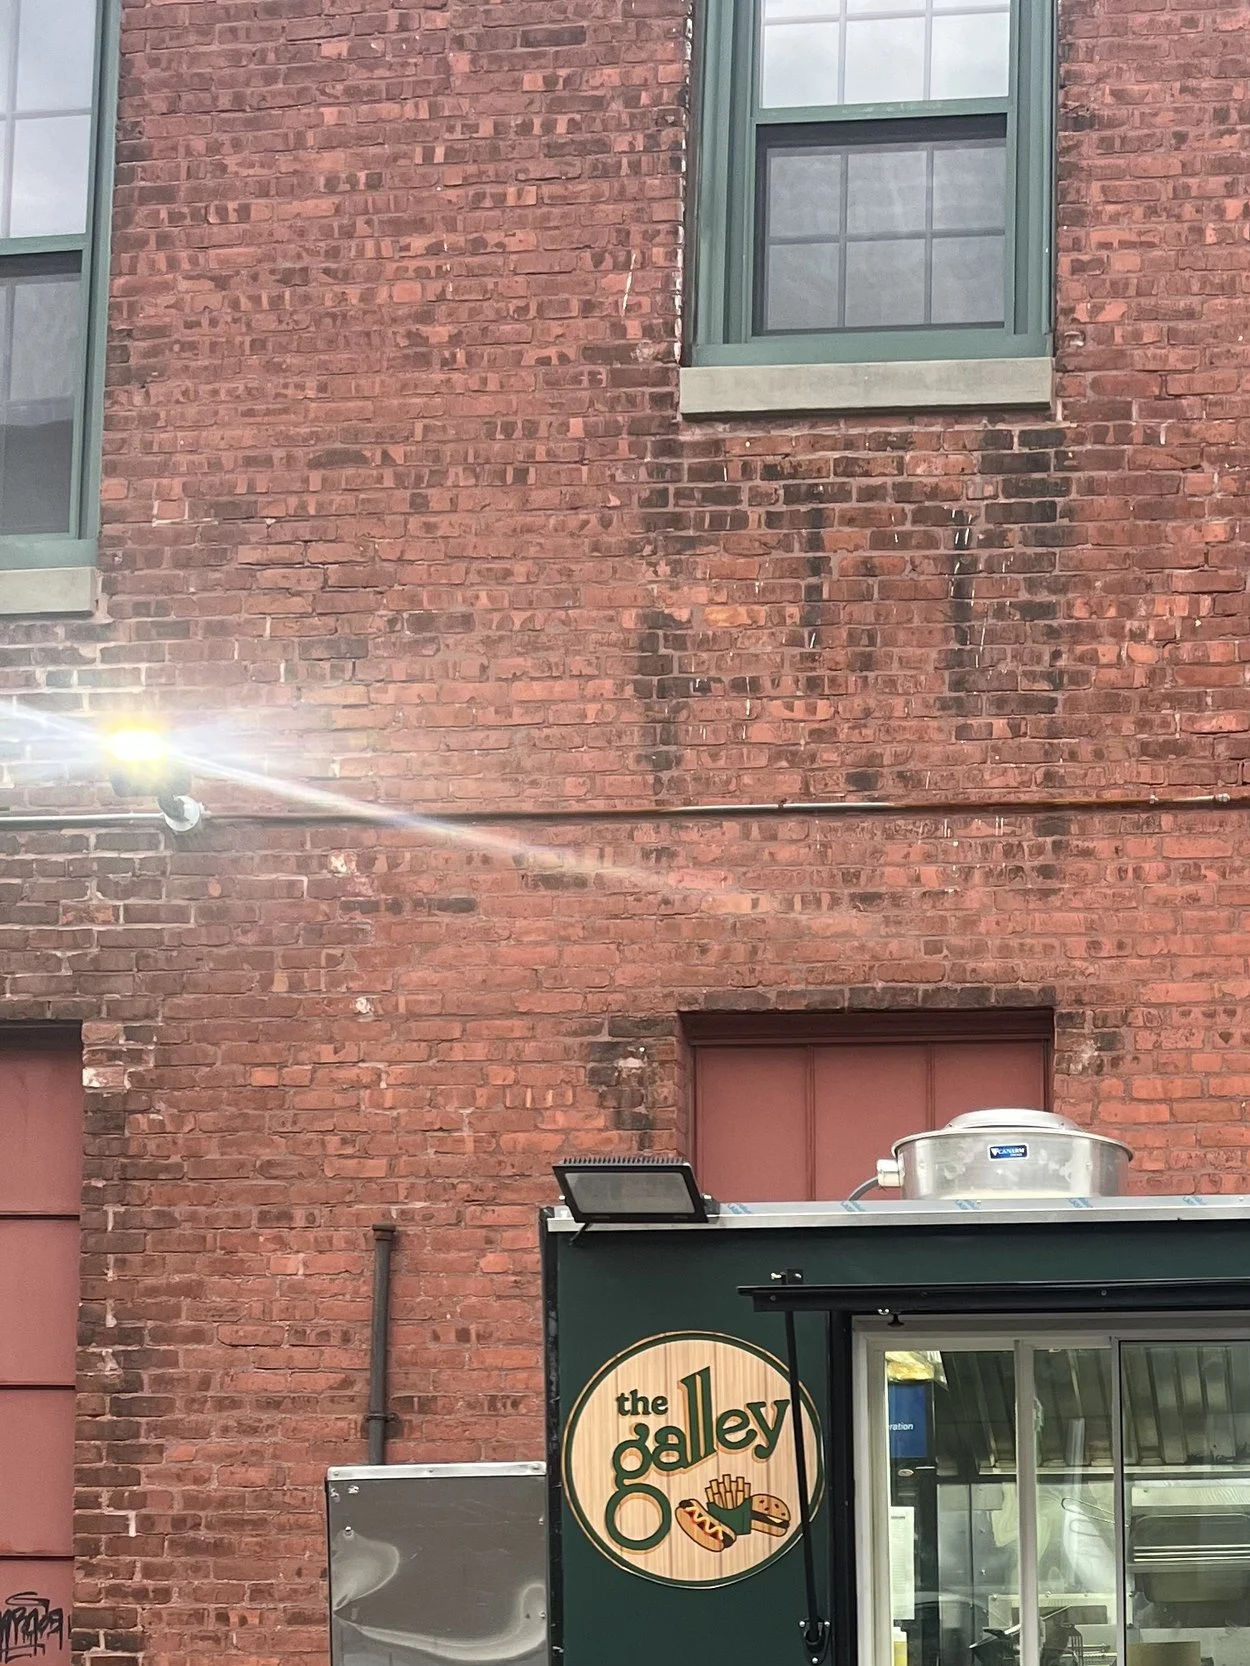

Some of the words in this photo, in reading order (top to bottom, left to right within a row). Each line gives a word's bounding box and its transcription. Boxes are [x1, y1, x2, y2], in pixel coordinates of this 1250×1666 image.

[616, 1389, 669, 1416] the
[889, 1421, 914, 1431] ration
[605, 1366, 790, 1551] galley
